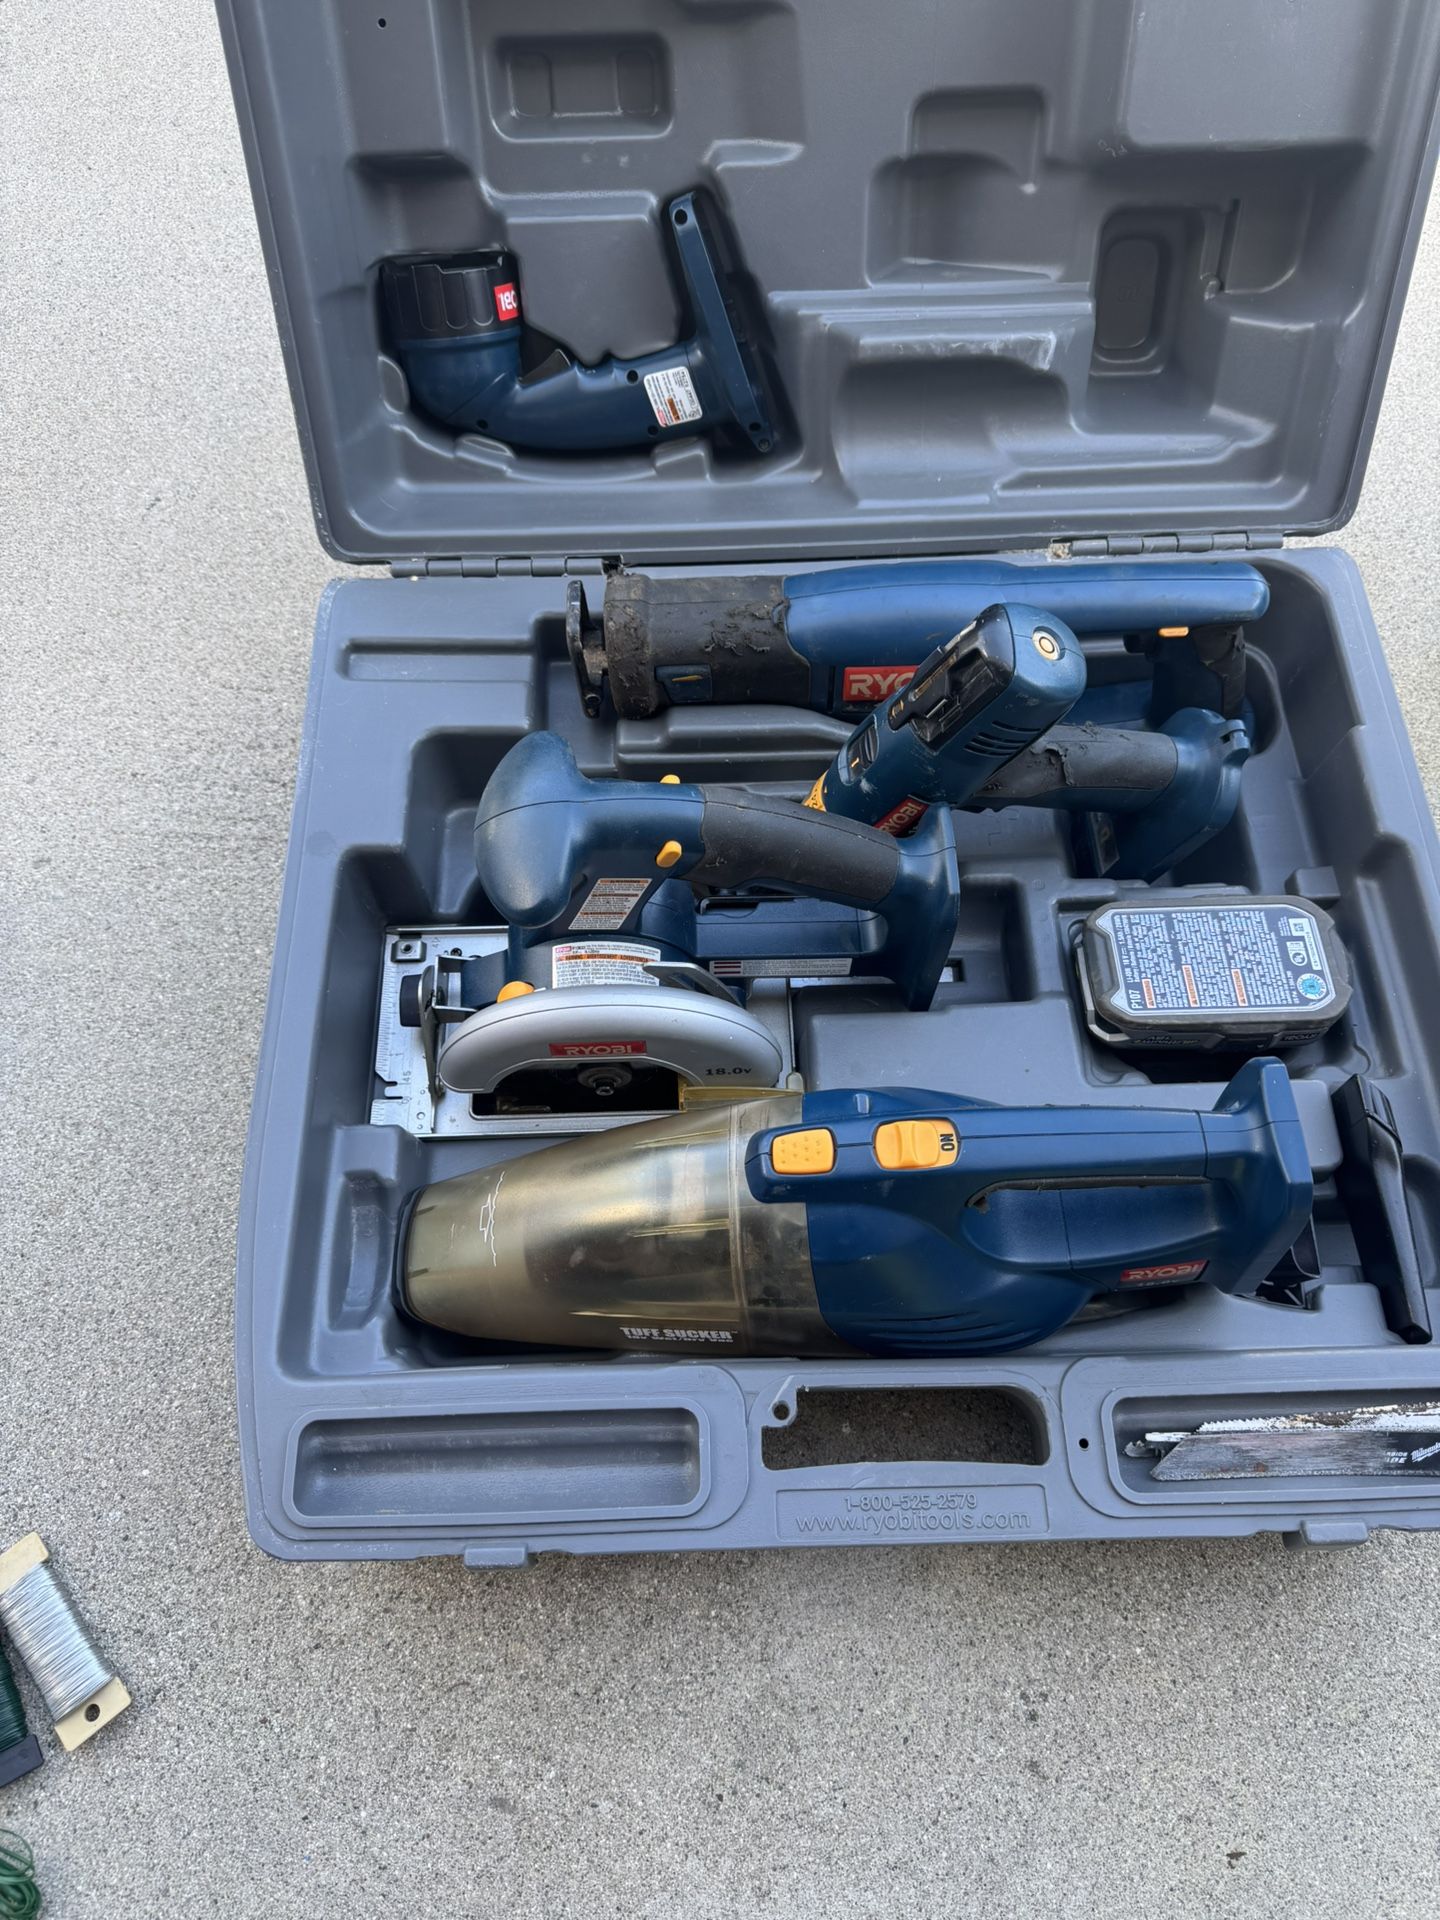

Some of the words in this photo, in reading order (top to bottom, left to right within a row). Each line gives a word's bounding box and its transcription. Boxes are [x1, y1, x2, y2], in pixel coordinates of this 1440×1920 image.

[1128, 989, 1142, 1008] P107
[564, 1045, 632, 1056] RYOBI
[939, 1133, 955, 1152] ON
[1128, 1265, 1200, 1280] RYOBI
[619, 1327, 659, 1337] TUFF
[844, 1493, 976, 1513] 1-800-525-2579
[795, 1509, 1031, 1535] www.ryobitools.com
